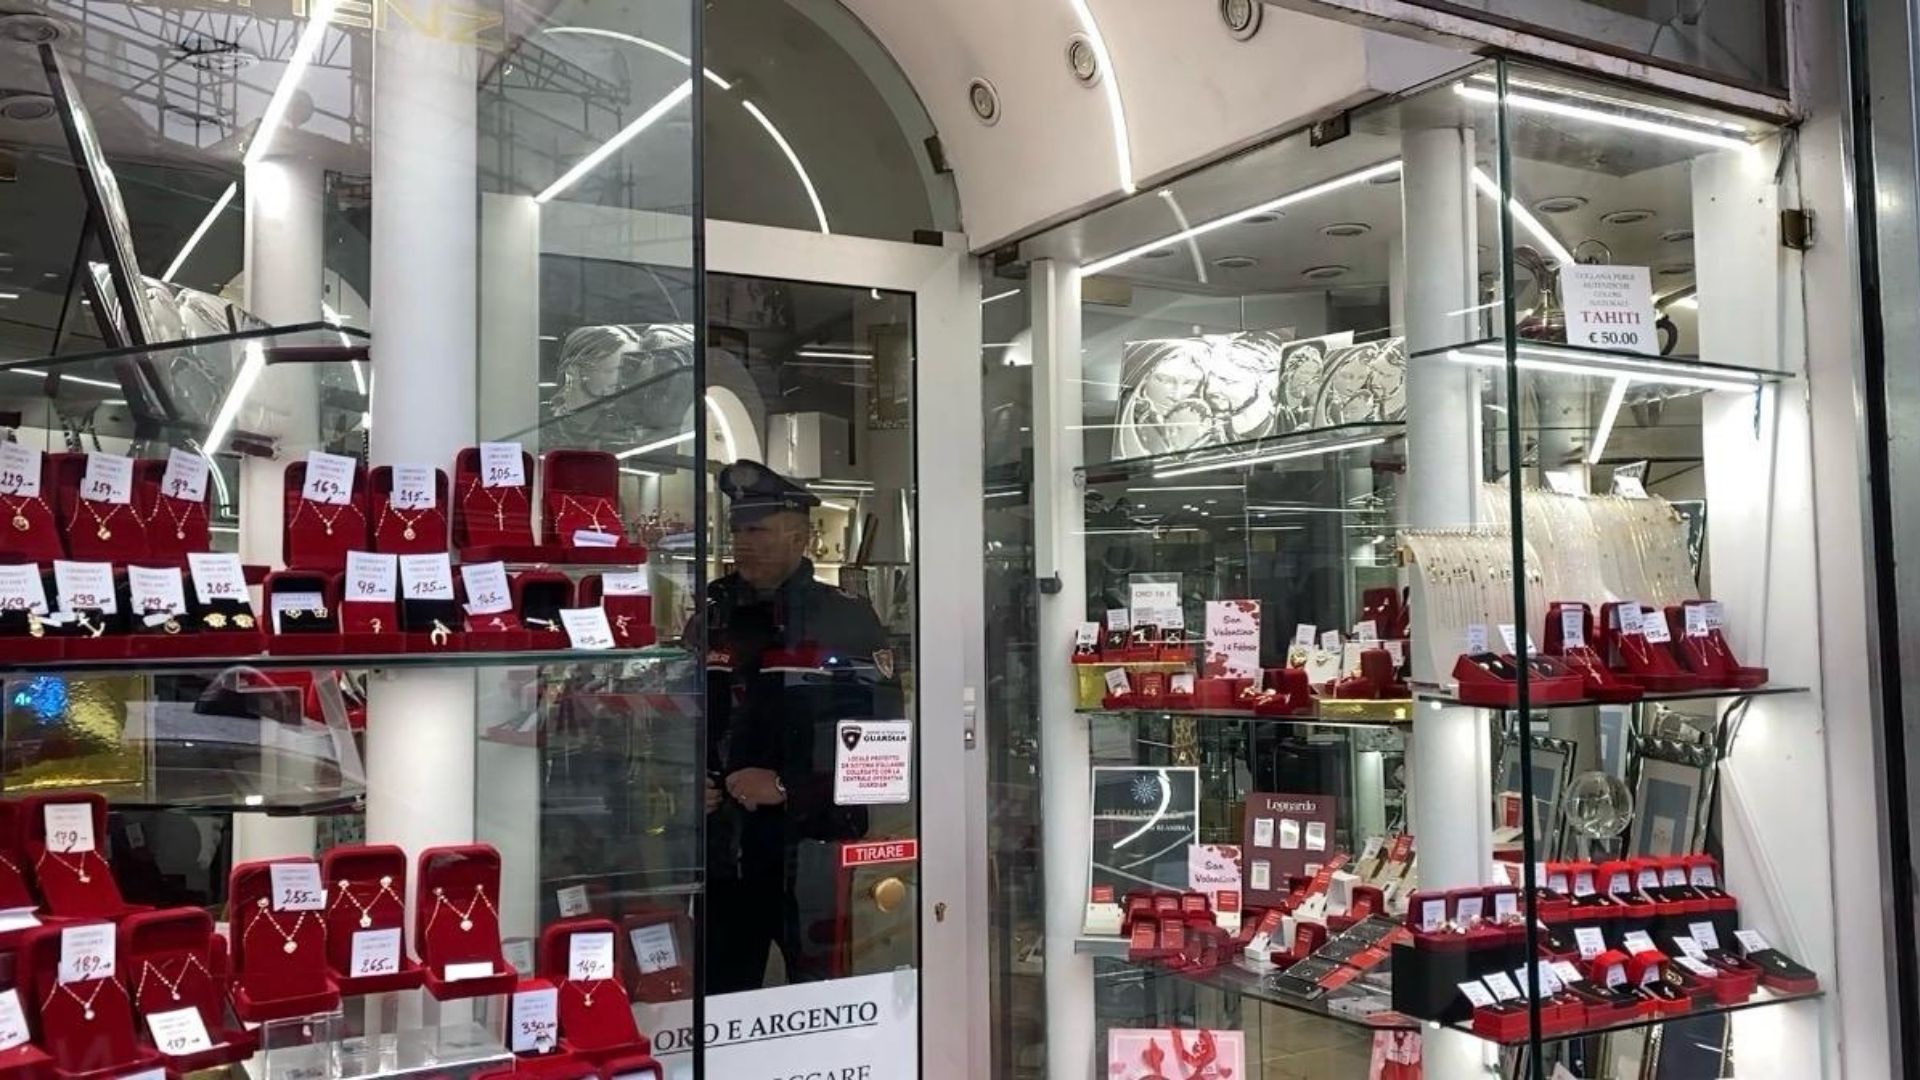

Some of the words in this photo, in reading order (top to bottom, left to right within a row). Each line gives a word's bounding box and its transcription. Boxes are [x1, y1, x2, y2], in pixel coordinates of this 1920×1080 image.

[1580, 311, 1640, 325] TAHITI
[1589, 332, 1598, 343] €
[1600, 332, 1638, 344] 50.00
[1223, 615, 1242, 624] San
[1212, 627, 1255, 637] Valentino
[856, 845, 904, 861] TIRARE
[1205, 860, 1224, 870] San
[654, 1023, 719, 1051] ORO
[728, 1020, 742, 1041] E
[750, 1001, 878, 1037] ARGENTO
